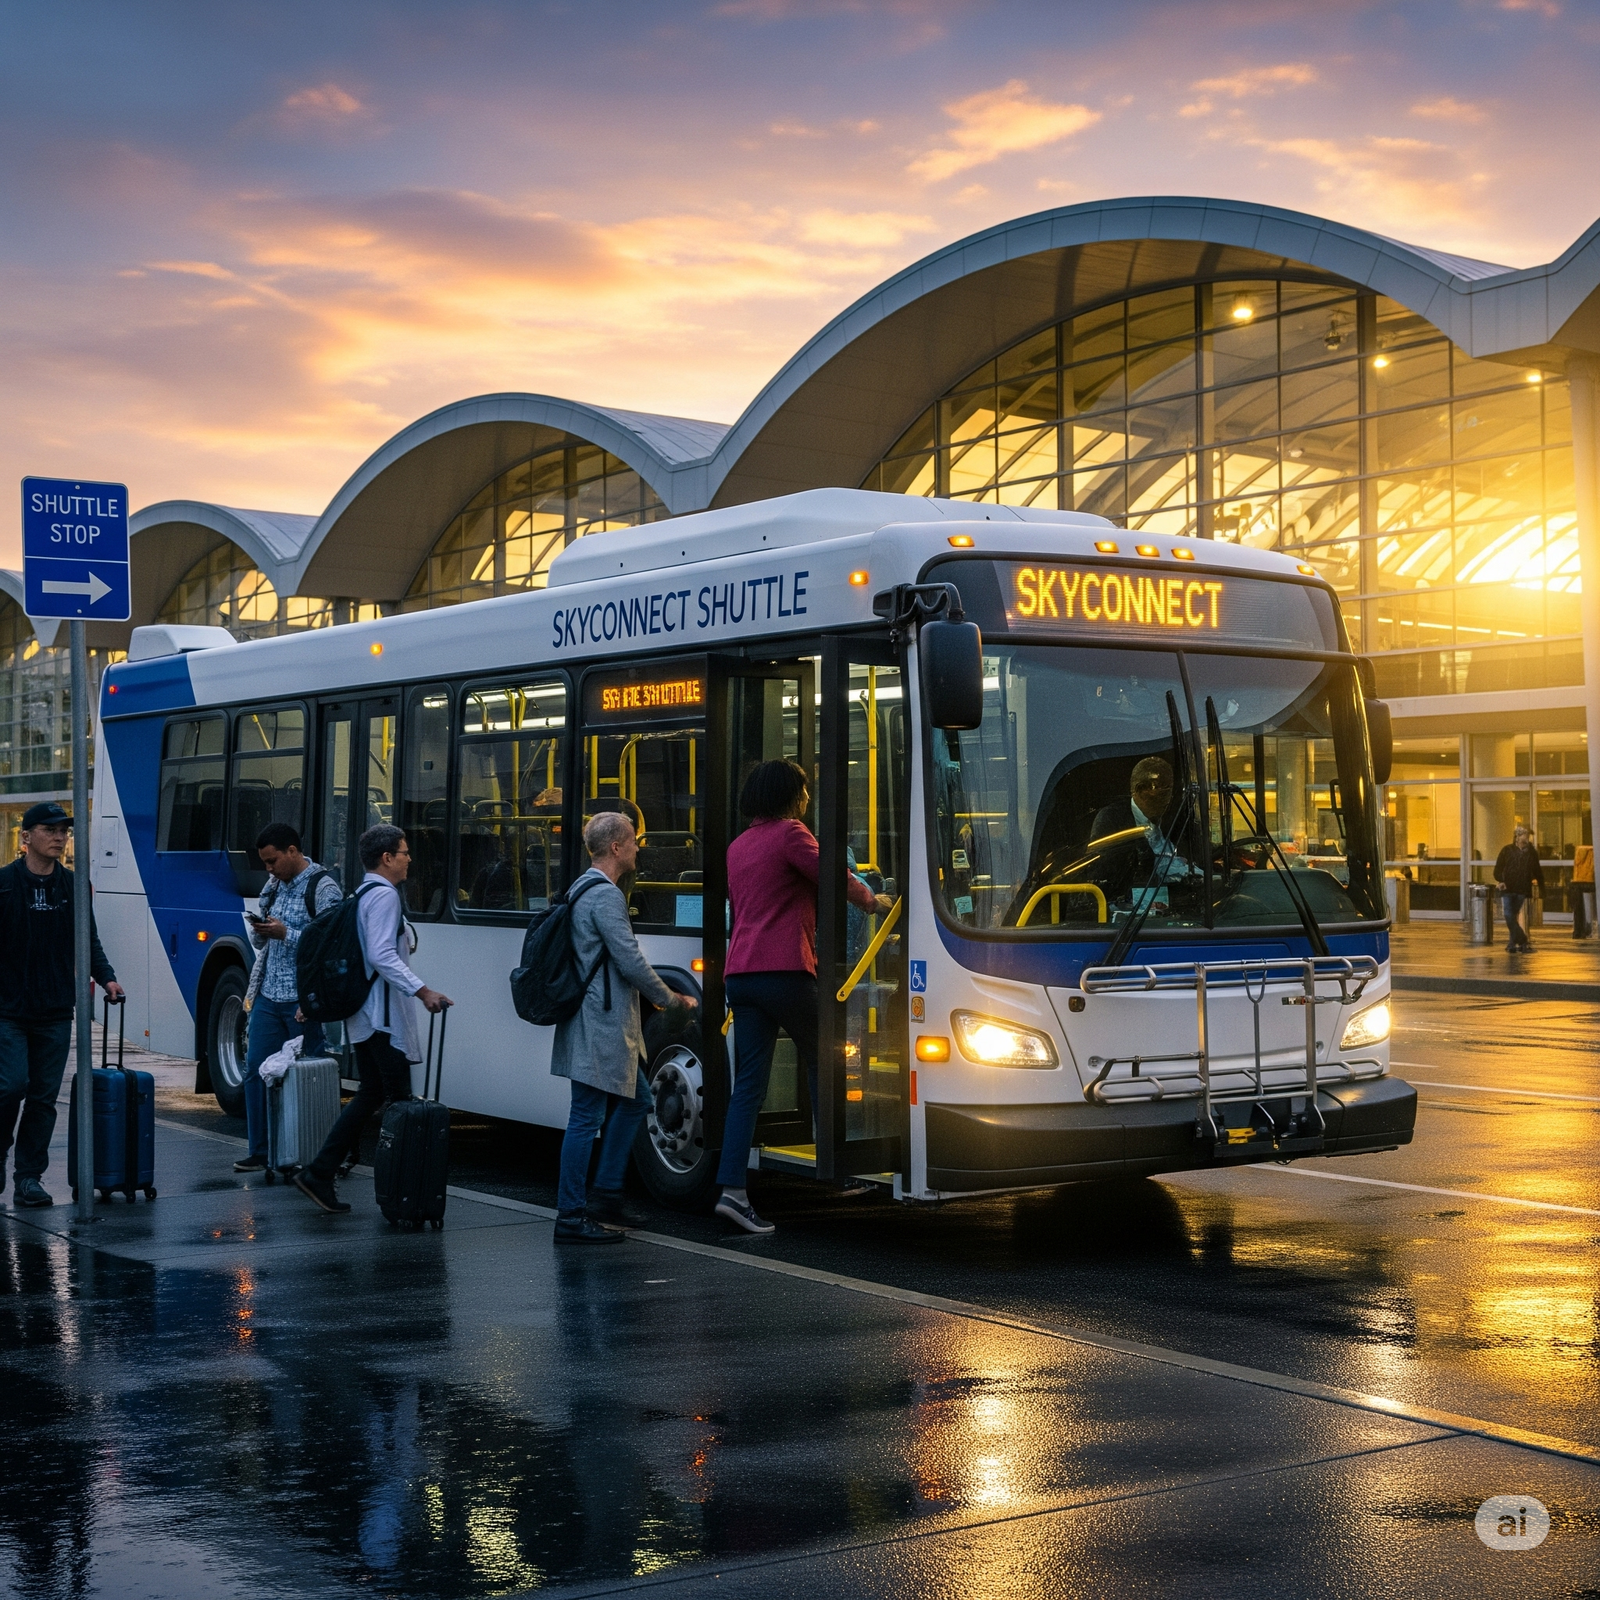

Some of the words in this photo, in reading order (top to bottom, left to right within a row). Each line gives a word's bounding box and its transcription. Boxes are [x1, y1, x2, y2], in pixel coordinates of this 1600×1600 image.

[31, 493, 119, 518] SHUTTLE
[50, 523, 101, 545] STOP
[552, 590, 691, 648] SKYCONNECT
[697, 571, 809, 628] SHUTTLE
[1016, 568, 1222, 628] SKYCONNECT
